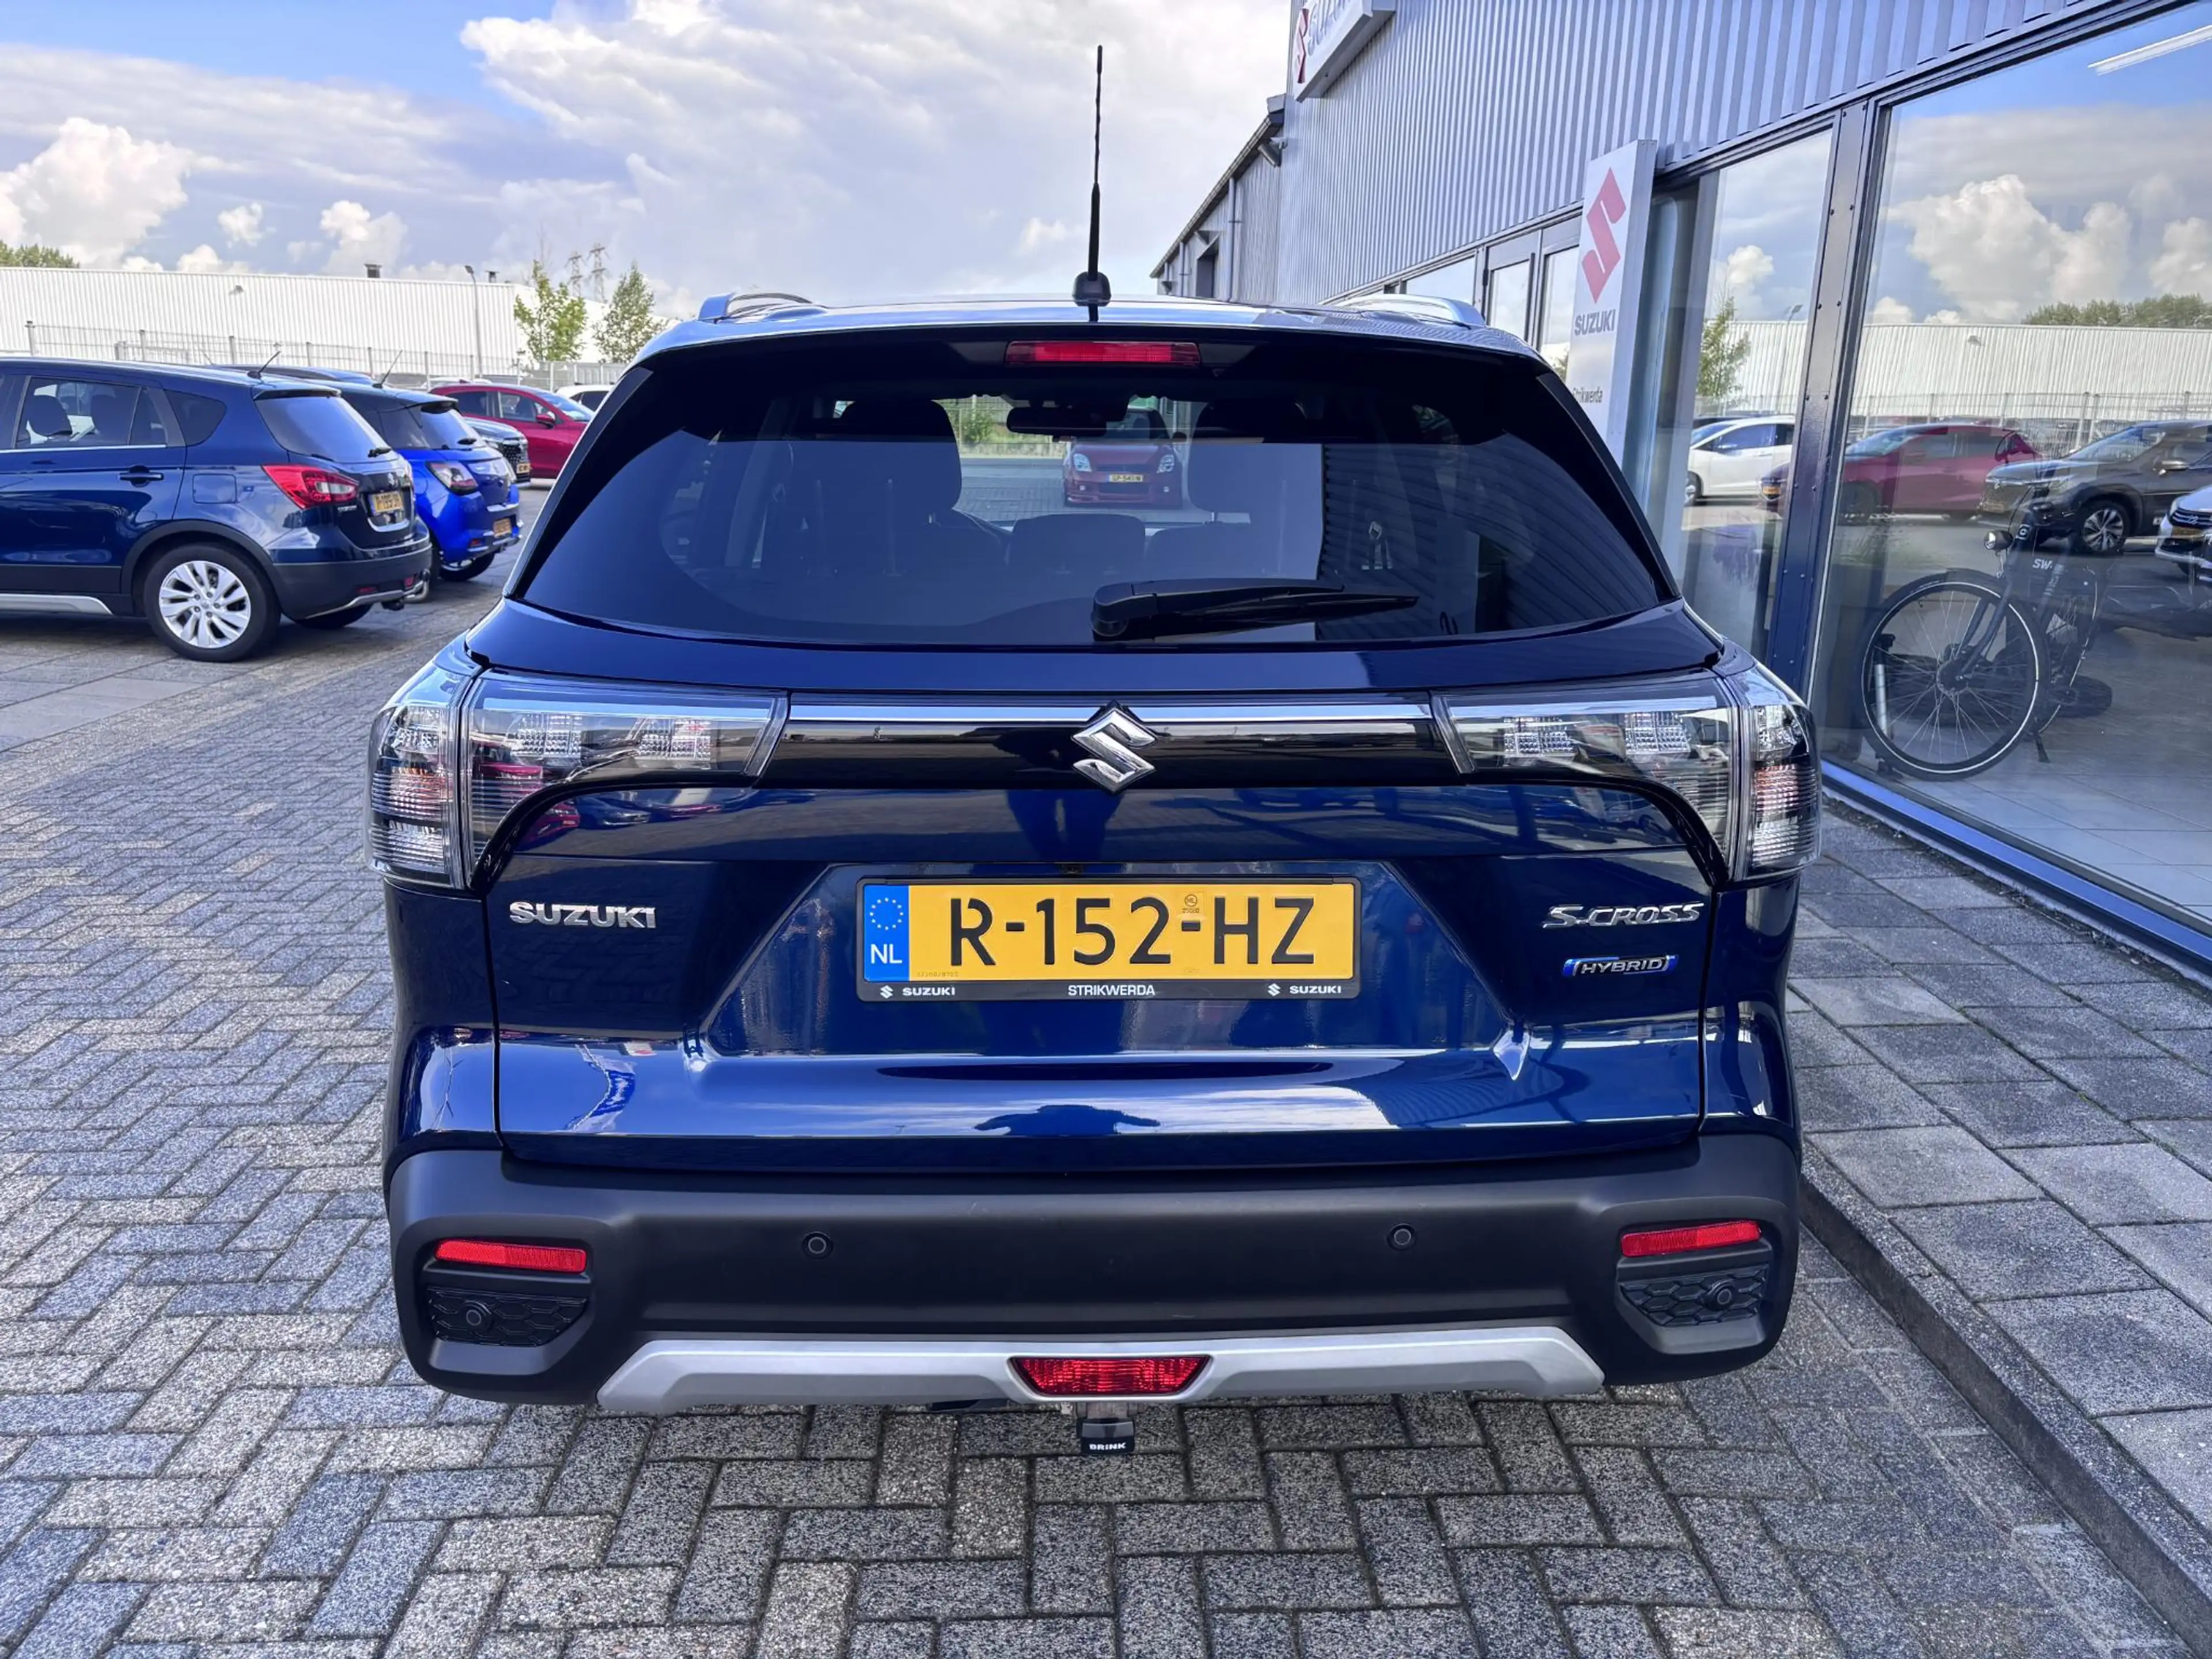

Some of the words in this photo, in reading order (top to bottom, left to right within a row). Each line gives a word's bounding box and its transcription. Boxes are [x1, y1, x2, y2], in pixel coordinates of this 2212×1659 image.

[1574, 309, 1616, 336] SUZUKI
[510, 902, 656, 928] SUZUKI
[870, 944, 903, 964] NL
[950, 896, 1315, 966] R-152-HZ
[1581, 959, 1664, 975] HYBRID
[902, 987, 956, 996] SUZUKI
[1068, 984, 1156, 997] STRIKWERDA
[1289, 985, 1342, 994] SUZUKI
[1089, 1442, 1126, 1450] BRINK
